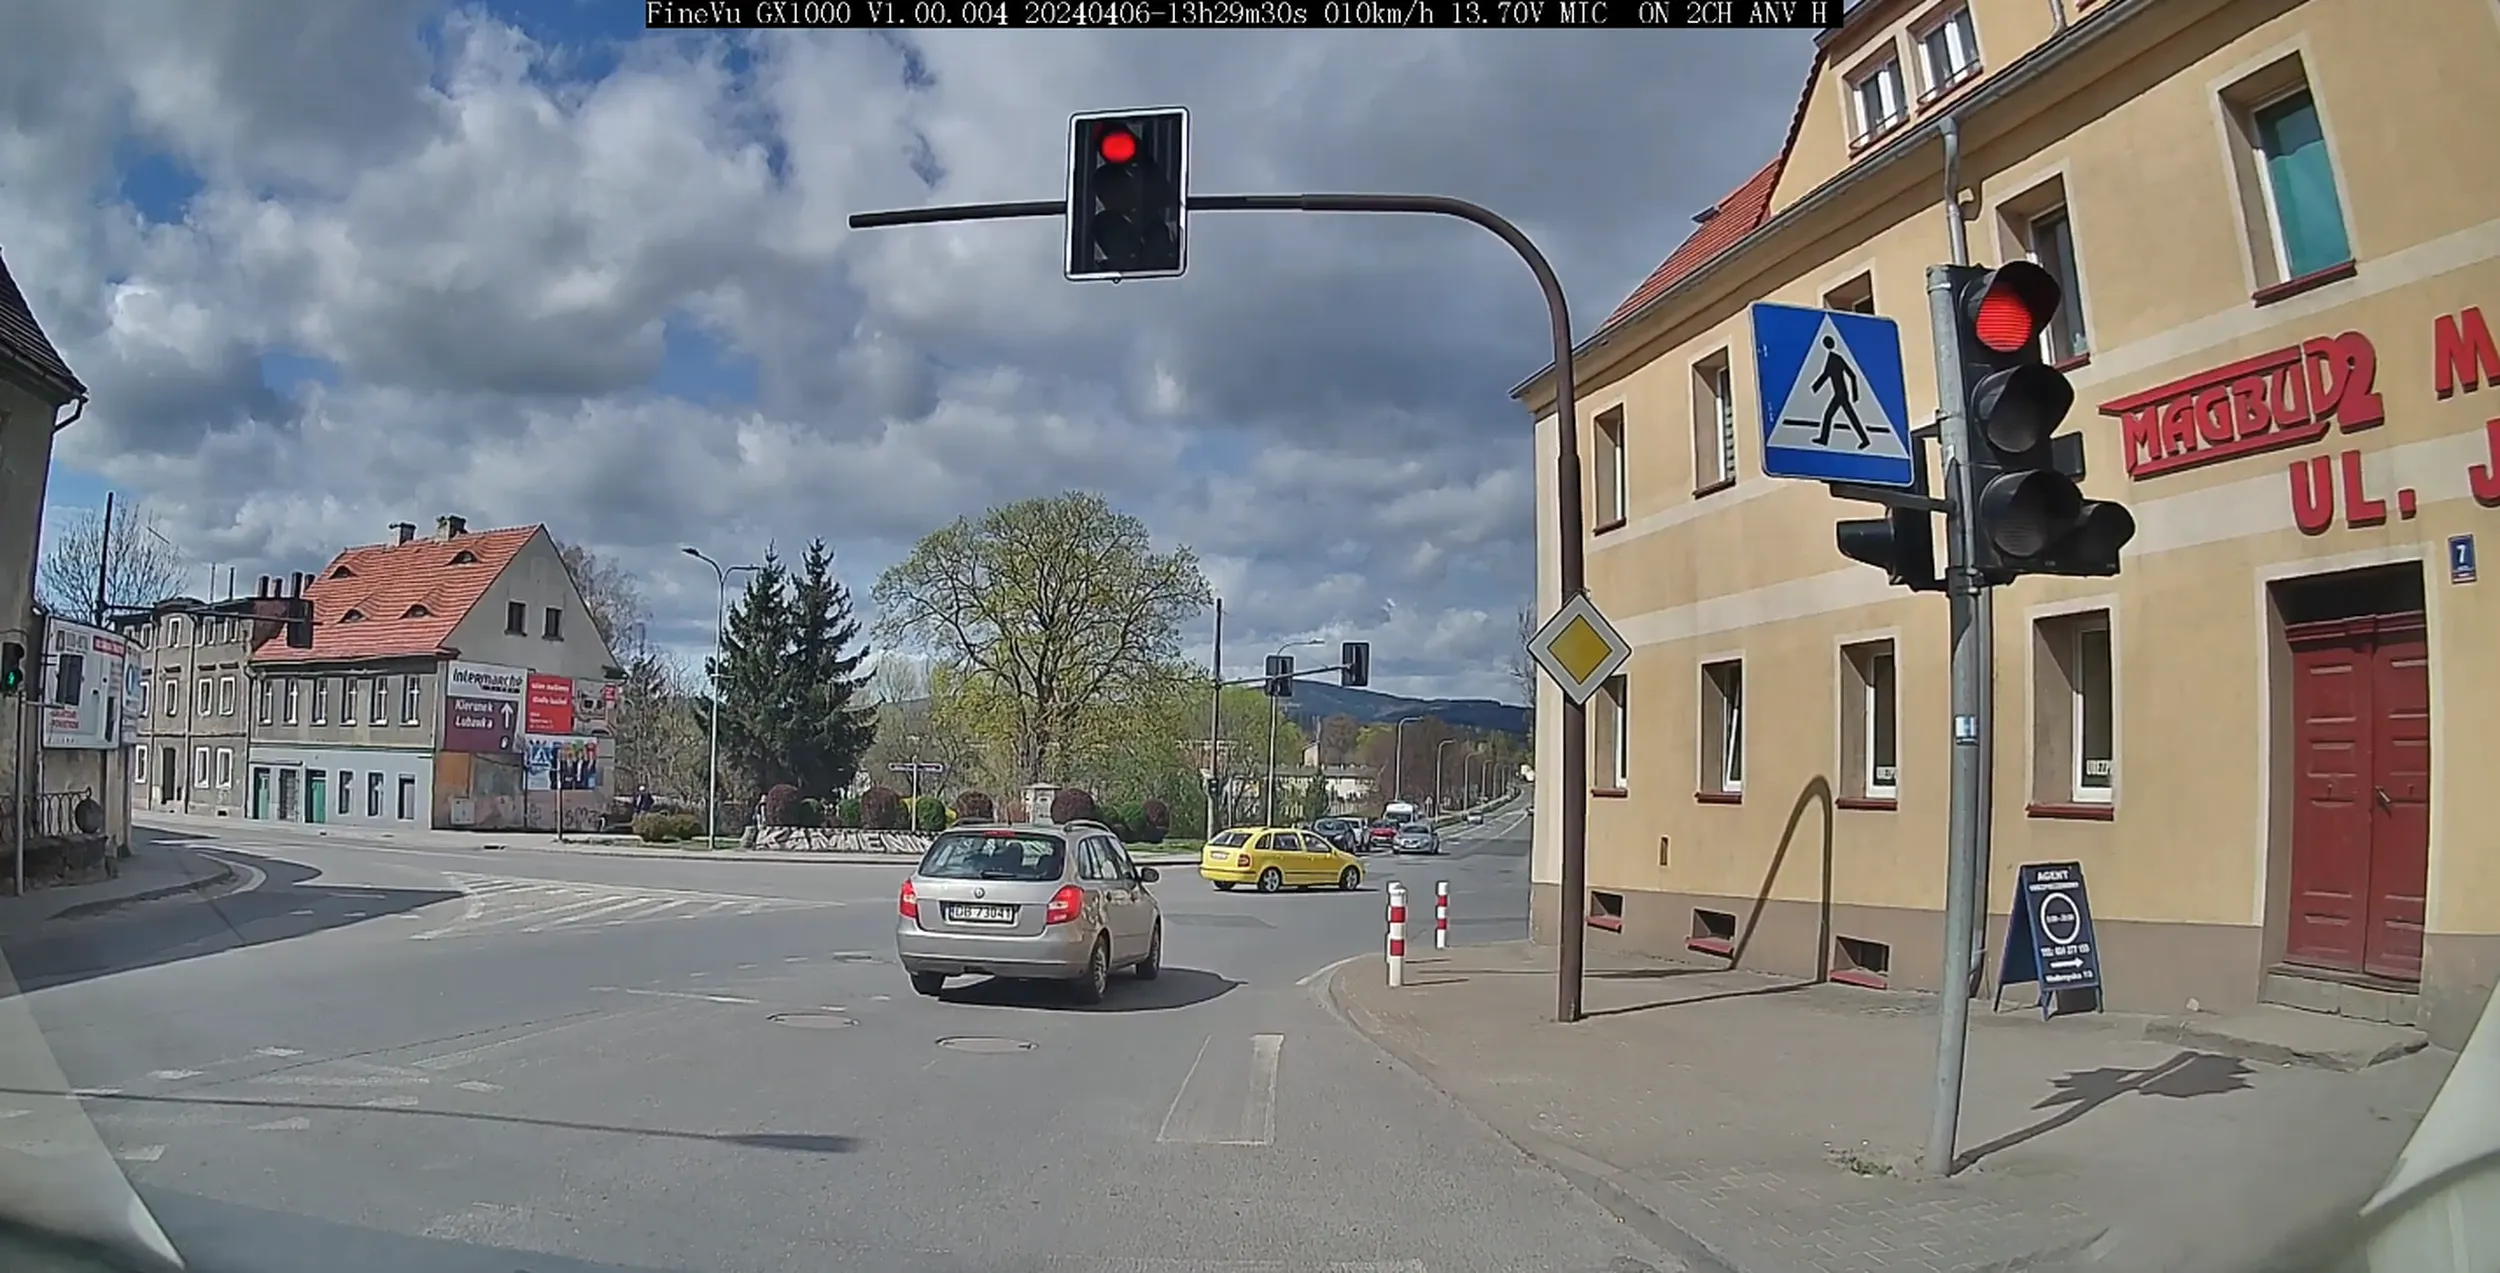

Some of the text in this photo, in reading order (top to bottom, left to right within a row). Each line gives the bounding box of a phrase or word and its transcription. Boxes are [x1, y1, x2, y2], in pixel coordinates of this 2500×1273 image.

[2288, 449, 2418, 536] UL.
[2455, 543, 2467, 564] 7
[2036, 869, 2069, 882] AGENT
